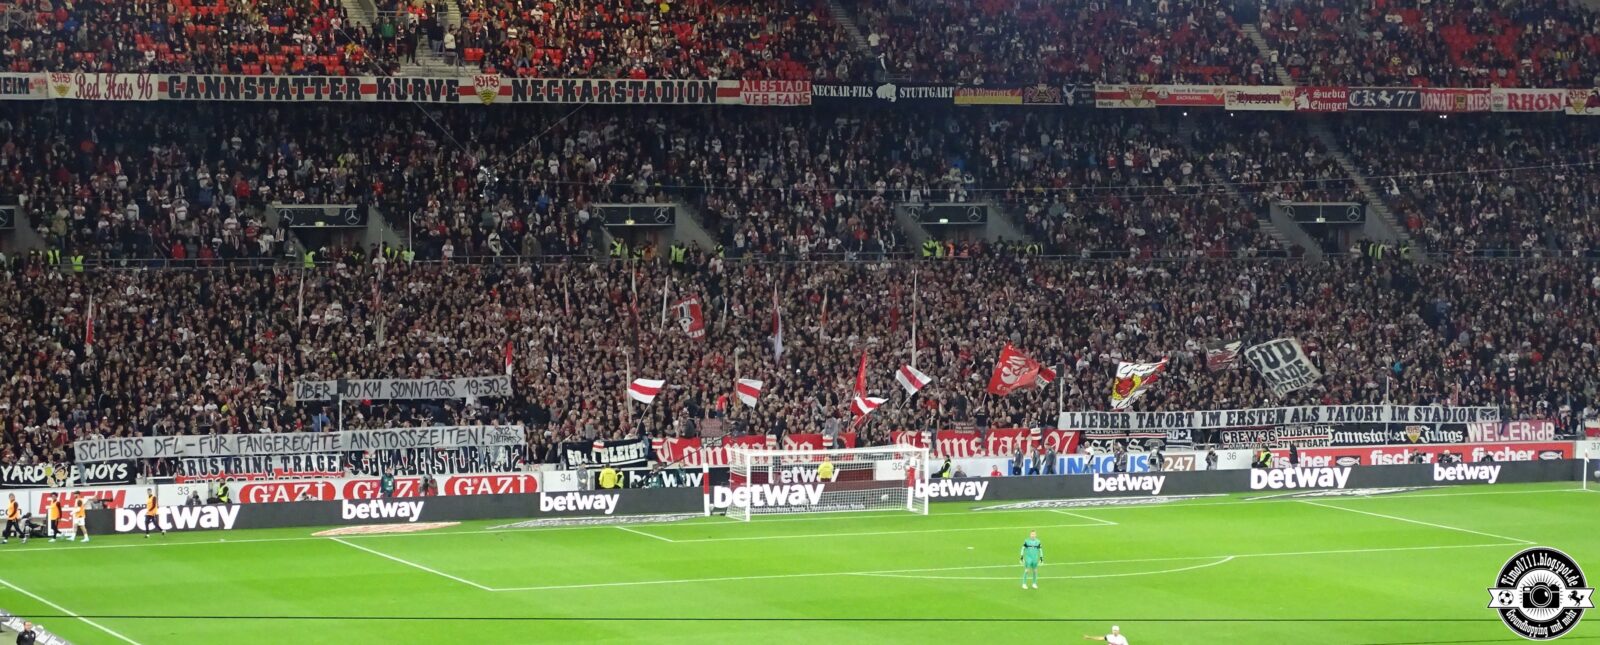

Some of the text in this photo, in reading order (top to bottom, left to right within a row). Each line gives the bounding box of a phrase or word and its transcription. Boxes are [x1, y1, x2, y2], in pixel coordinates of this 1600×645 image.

[75, 73, 153, 100] Red Hots 96
[168, 75, 460, 102] CANNSTATTER KURVE
[512, 79, 718, 103] NECKARSTADION
[742, 80, 811, 92] ALBSTADT
[812, 84, 955, 99] NECKAR-FILS STUTTGART
[743, 92, 811, 104] VFB-FANS
[1396, 89, 1416, 107] 77
[1421, 92, 1454, 110] DONAU
[1466, 92, 1491, 110] RIES
[1507, 92, 1563, 111] RHÖN
[296, 381, 331, 399] ÜBER
[390, 380, 456, 398] SONNTAGS
[464, 378, 509, 396] 19:30?
[1069, 407, 1477, 428] LIEBER TATORT IM ERSTEN ALS TATORT IM STADION
[79, 440, 144, 460] SCHEISS
[237, 432, 342, 453] FANGERECHTE
[351, 427, 486, 449] ANSTOSSZEITEN!
[896, 428, 1041, 459] Cnnstatt
[1045, 430, 1076, 455] 97
[177, 455, 273, 477] BRUSTRING
[893, 462, 903, 471] 35
[1164, 456, 1195, 472] 247
[1226, 452, 1237, 461] 36
[1271, 452, 1332, 467] isher
[560, 473, 571, 483] 34
[1251, 467, 1352, 489] betway
[1433, 461, 1502, 484] betway
[177, 486, 190, 496] 33
[915, 478, 989, 500] betway
[1093, 472, 1166, 495] betway
[540, 490, 620, 514] betway
[713, 483, 825, 509] betway
[342, 499, 424, 521] betway
